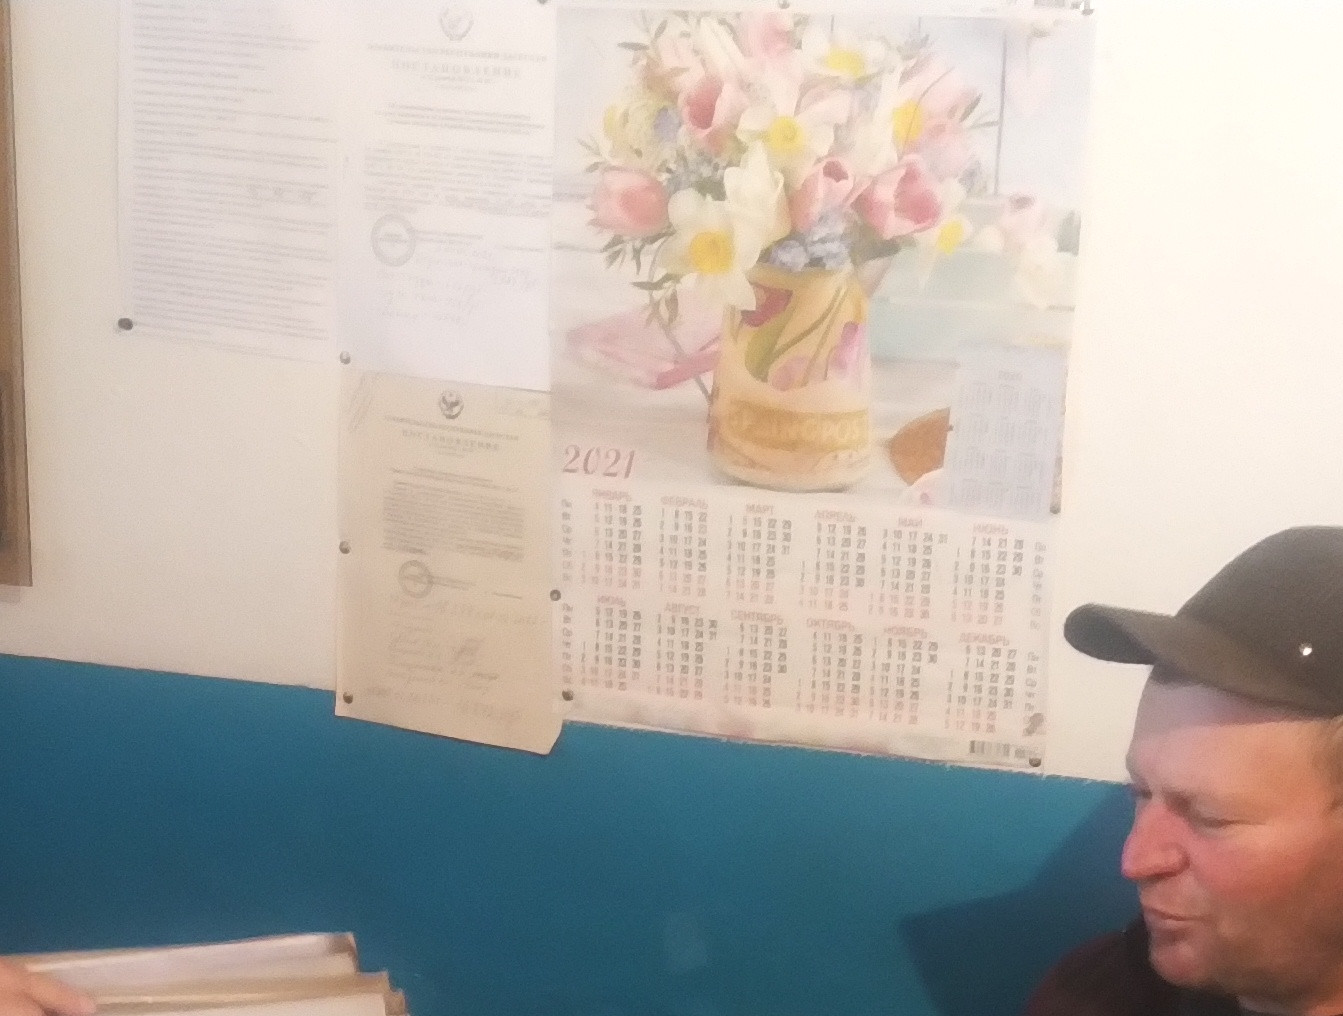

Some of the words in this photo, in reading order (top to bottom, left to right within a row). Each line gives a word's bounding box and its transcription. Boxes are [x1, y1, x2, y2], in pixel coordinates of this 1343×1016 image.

[563, 445, 635, 479] 2021
[747, 504, 773, 514] МАРТ
[665, 602, 699, 614] АВГУСТ
[731, 610, 783, 625] СЕНТЯБРЬ
[807, 618, 855, 631] ОКТЯБРЬ
[959, 633, 1009, 646] ДЕКАБРЬ
